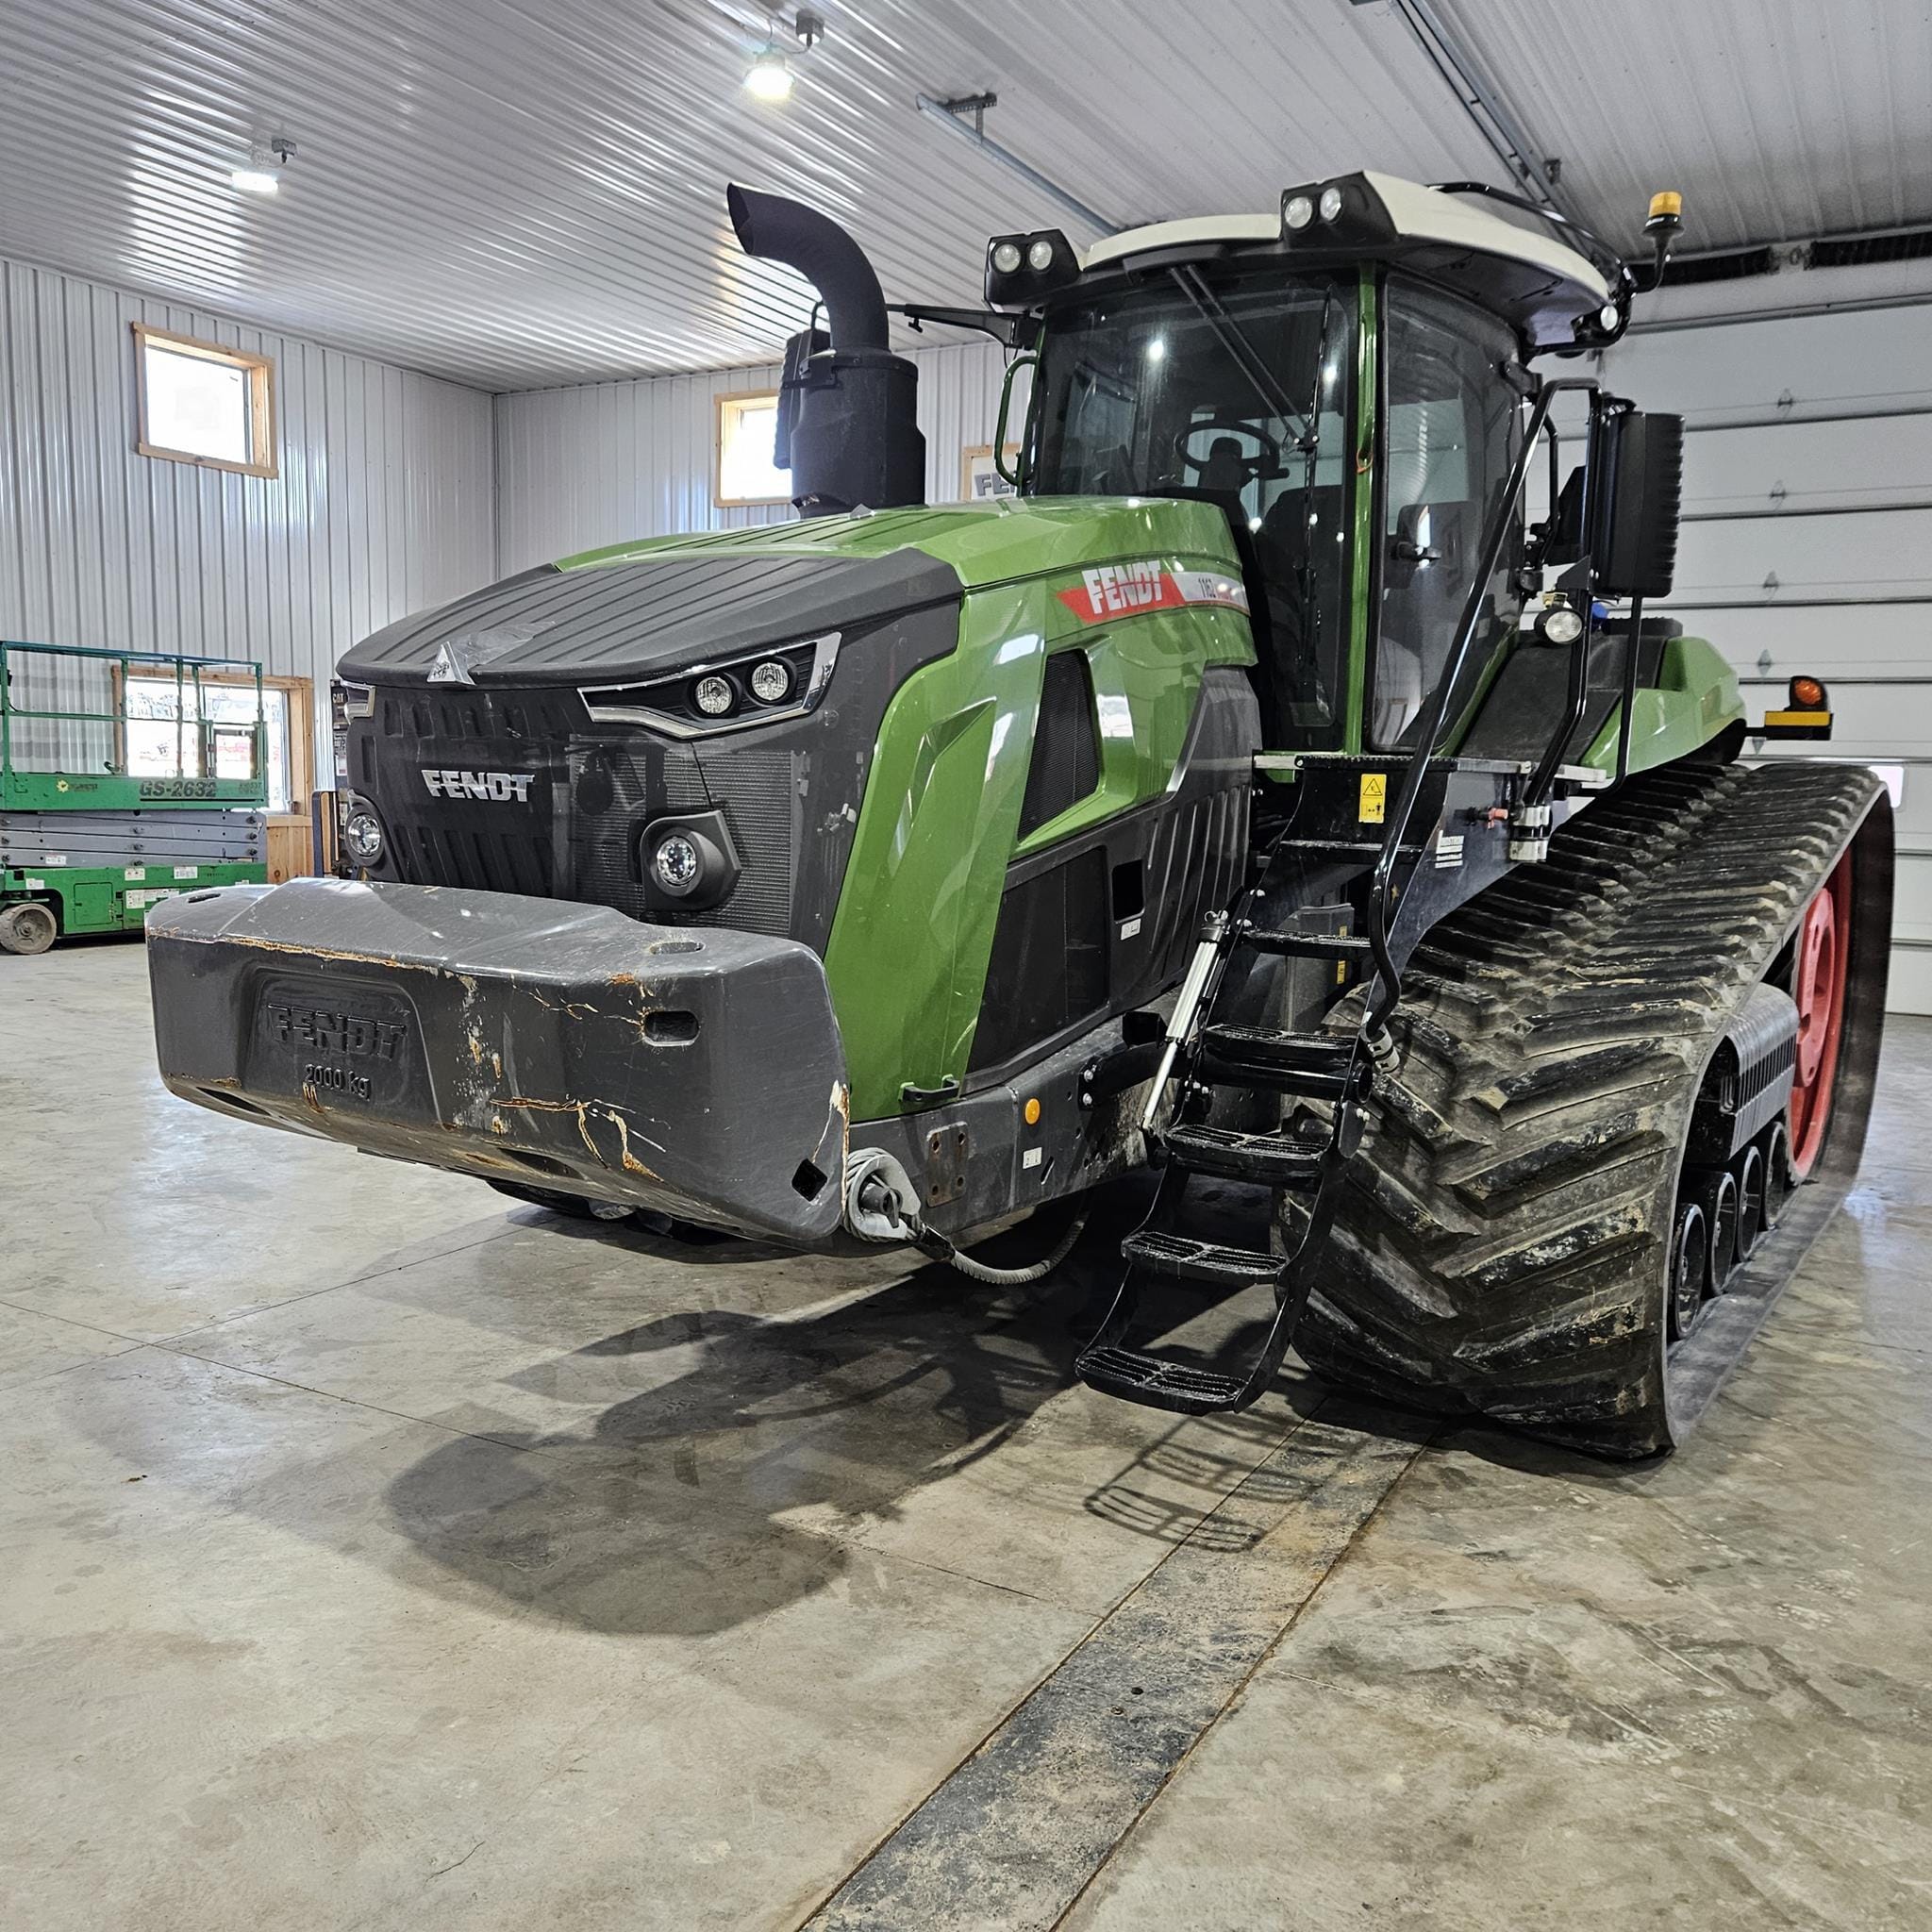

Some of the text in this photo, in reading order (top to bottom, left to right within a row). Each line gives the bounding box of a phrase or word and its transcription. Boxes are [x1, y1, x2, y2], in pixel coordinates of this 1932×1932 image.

[974, 473, 1015, 497] FE
[1081, 560, 1160, 614] FENDT
[140, 780, 217, 797] GS-2632
[421, 769, 535, 802] FENDT
[268, 1003, 408, 1061] FENDT
[304, 1063, 371, 1102] 2000 kg
